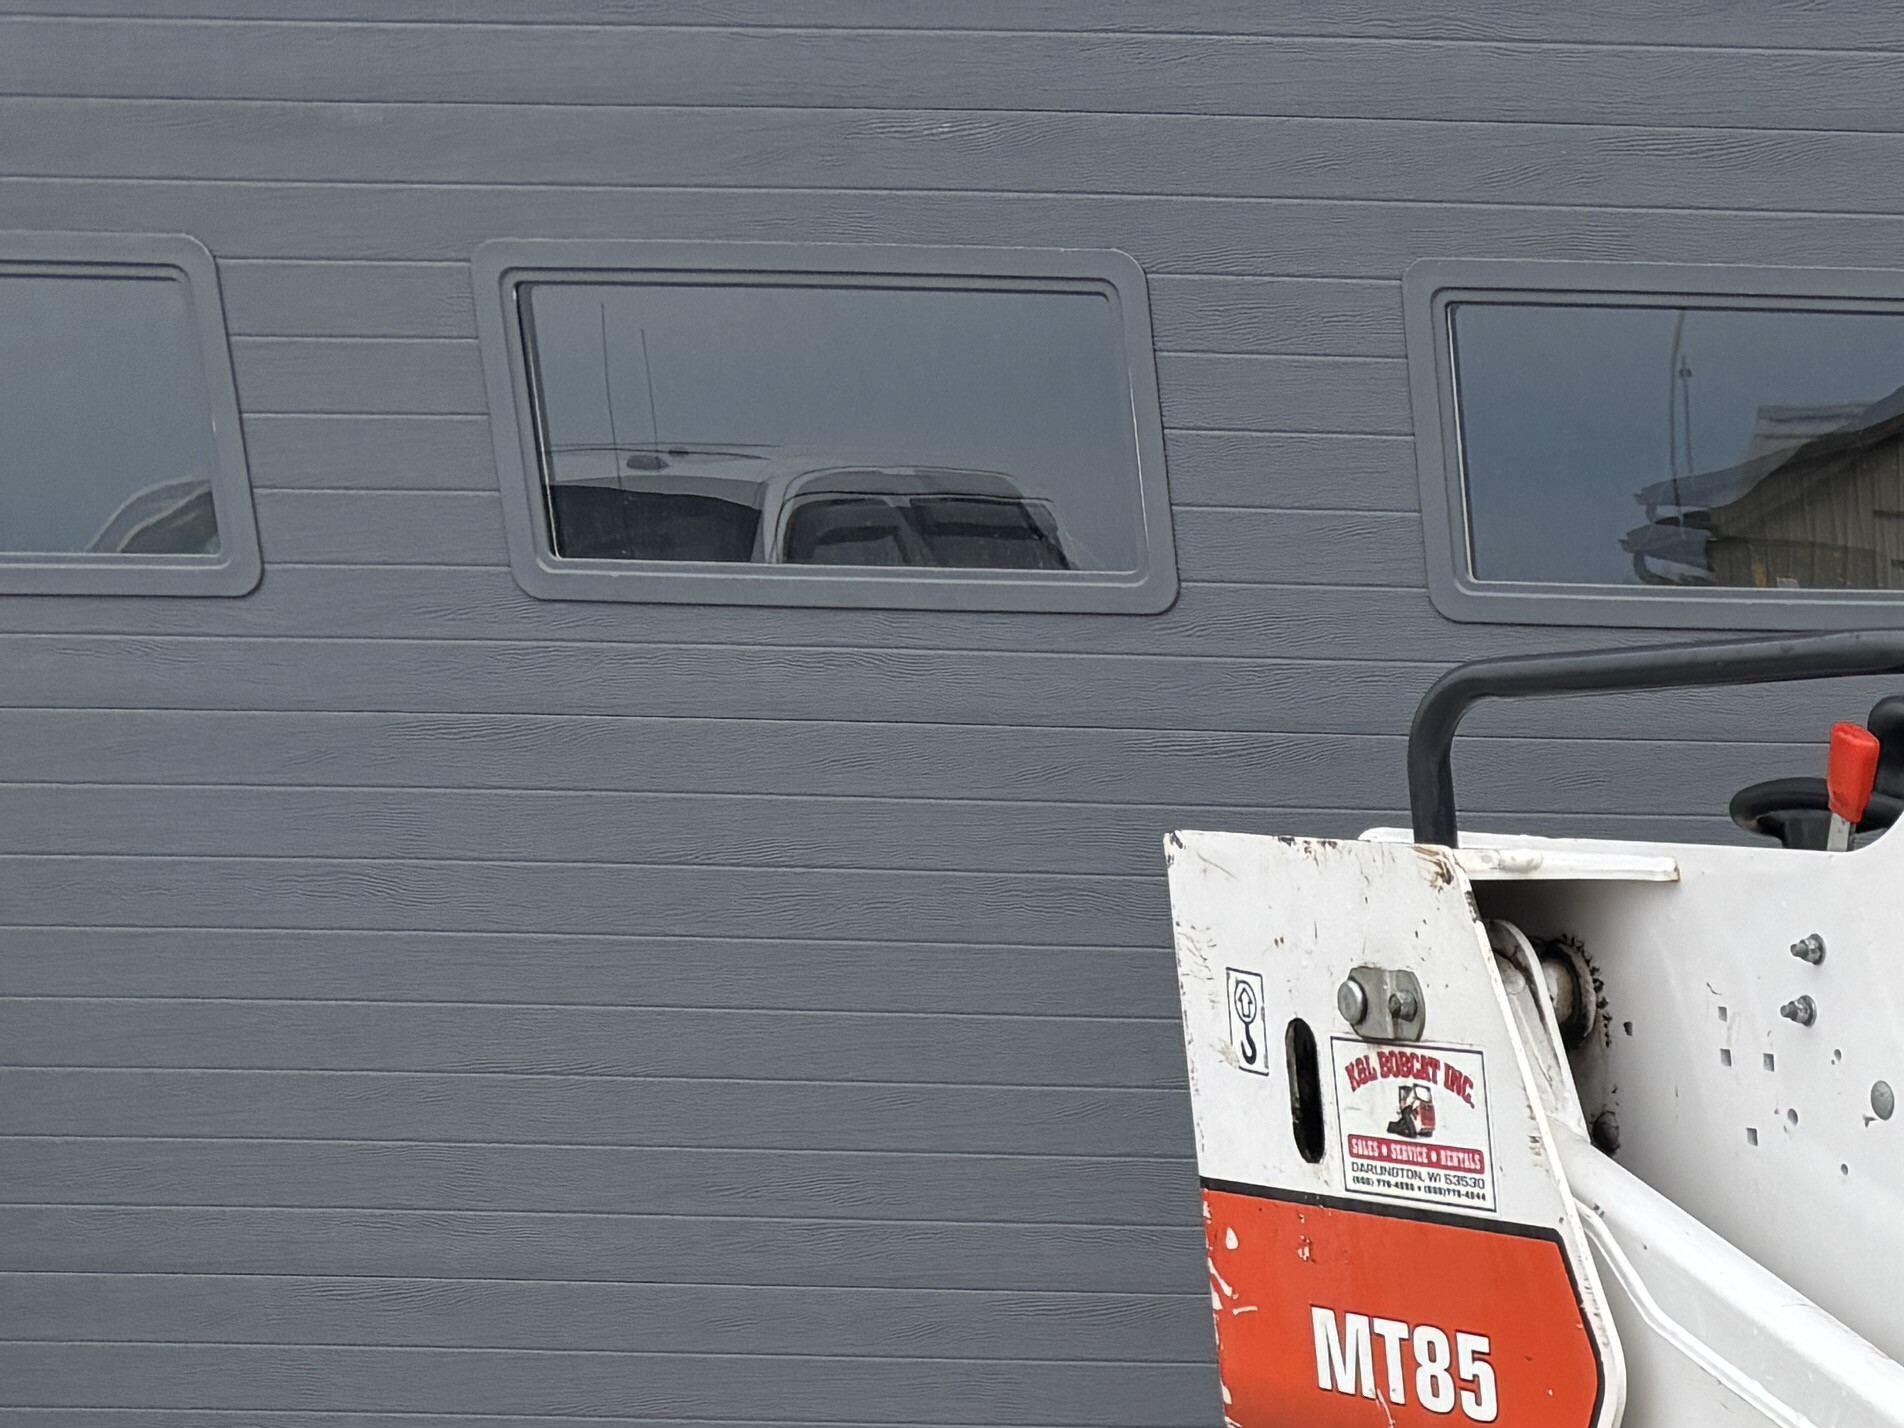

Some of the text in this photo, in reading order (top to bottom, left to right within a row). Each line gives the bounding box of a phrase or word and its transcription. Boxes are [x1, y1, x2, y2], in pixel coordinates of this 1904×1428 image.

[1345, 1055, 1378, 1092] K&L
[1377, 1050, 1440, 1085] BOBCAT
[1352, 1139, 1480, 1169] SALES SERVICE RENTALS
[1427, 1171, 1441, 1183] WI
[1444, 1173, 1485, 1189] 53530
[1310, 1305, 1498, 1422] MT85
